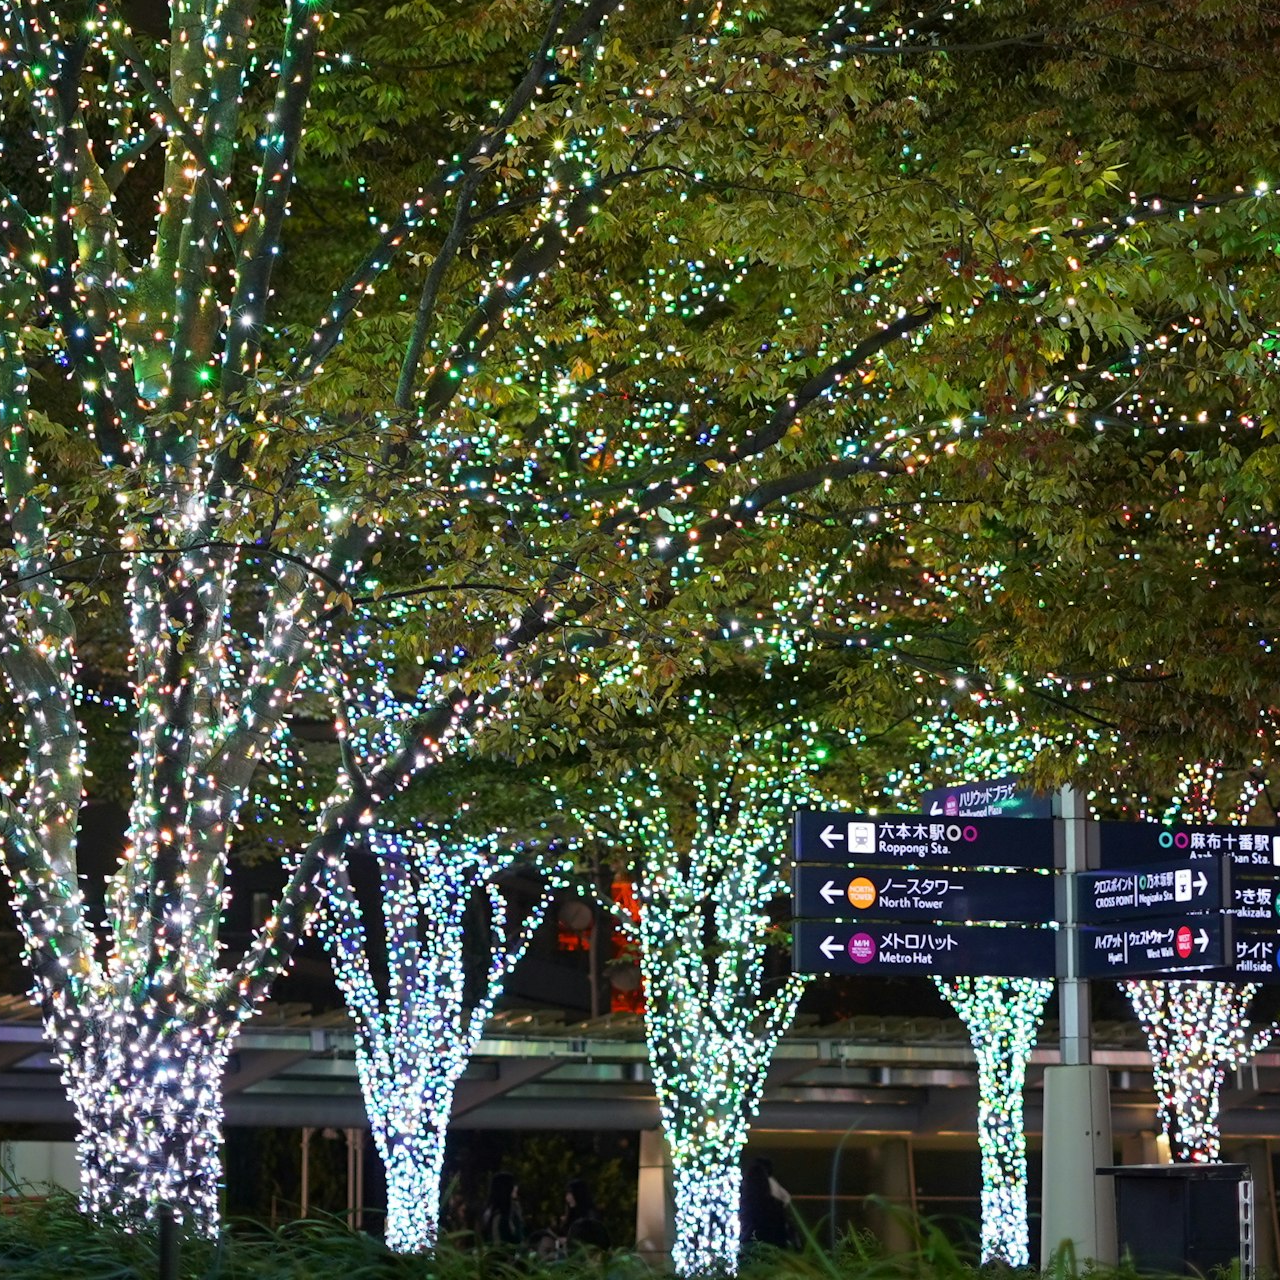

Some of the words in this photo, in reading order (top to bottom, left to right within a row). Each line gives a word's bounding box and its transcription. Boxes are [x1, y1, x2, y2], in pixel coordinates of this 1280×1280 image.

[879, 823, 945, 840] 六本木駅
[879, 841, 929, 857] Roppongi
[931, 842, 951, 855] Sta.
[1190, 832, 1270, 852] 麻布十番駅
[1251, 851, 1271, 864] Sta.
[879, 878, 964, 895] ノースタワー
[1094, 877, 1134, 895] クロスポイント
[879, 896, 911, 908] North
[912, 896, 943, 909] Tower
[1095, 895, 1115, 909] CROSS
[1115, 894, 1134, 907] POINT
[880, 933, 958, 950] メトロハット
[1094, 933, 1123, 950] ハイアット
[879, 951, 912, 963] Metro
[914, 952, 933, 964] Hat
